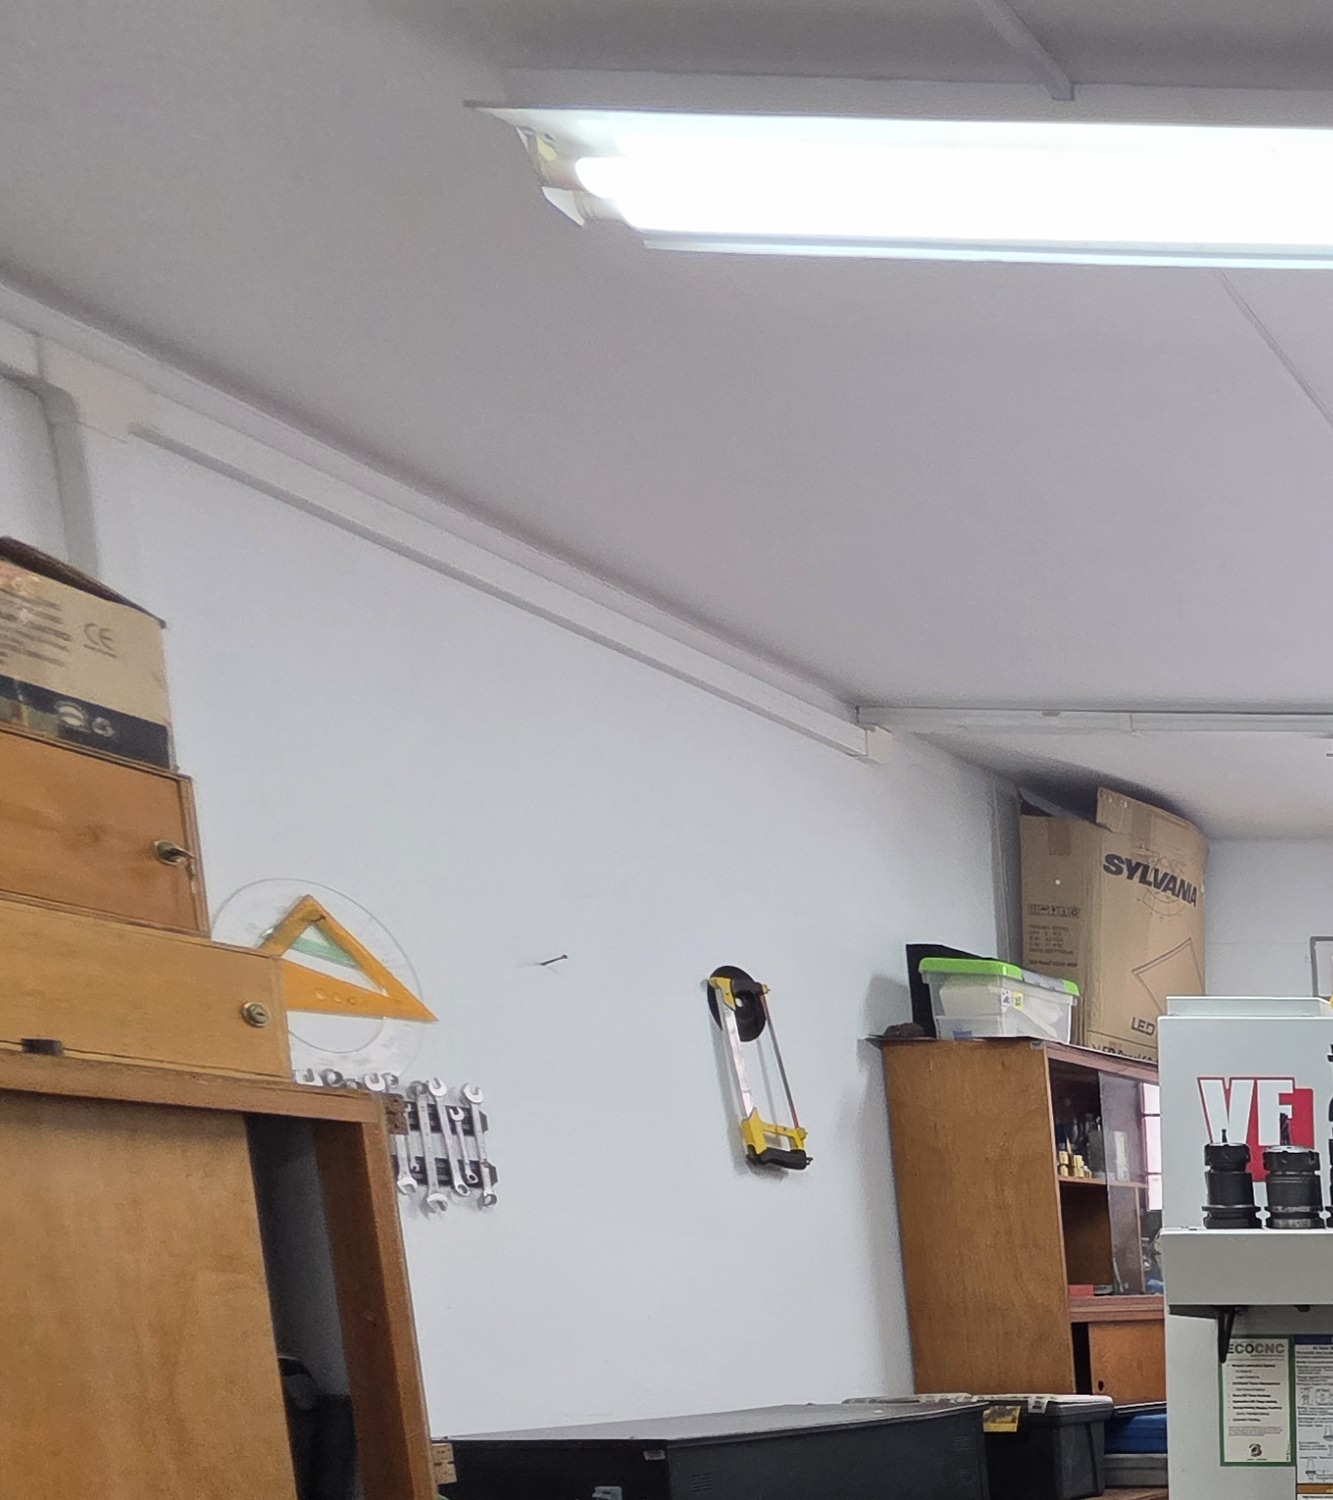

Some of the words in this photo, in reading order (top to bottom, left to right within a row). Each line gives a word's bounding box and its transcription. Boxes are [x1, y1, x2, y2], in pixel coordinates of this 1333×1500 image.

[1103, 853, 1198, 908] SYLVANIA
[1131, 1016, 1156, 1037] LED
[1227, 1343, 1285, 1354] ECOCNC
